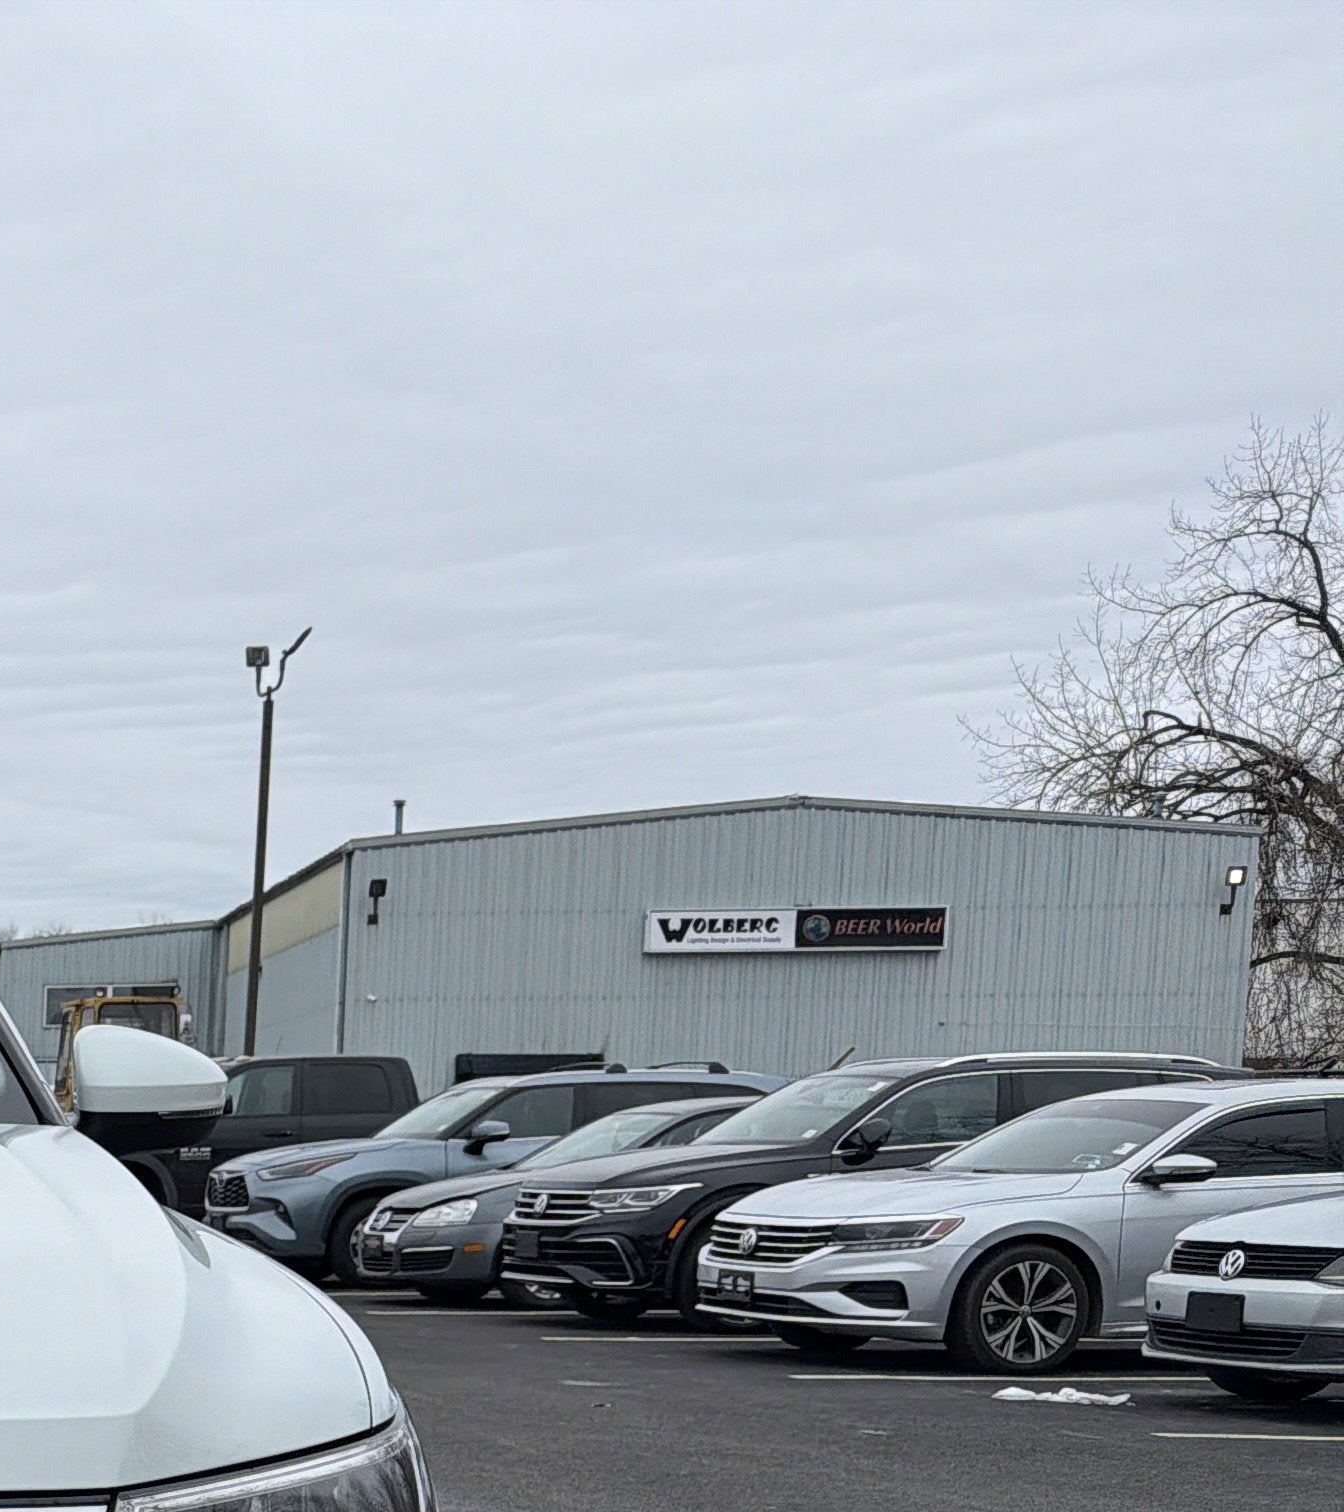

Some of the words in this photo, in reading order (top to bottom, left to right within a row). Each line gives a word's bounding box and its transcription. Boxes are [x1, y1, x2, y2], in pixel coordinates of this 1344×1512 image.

[656, 916, 780, 943] WOLBERG
[833, 918, 881, 935] BEER
[885, 915, 943, 934] World
